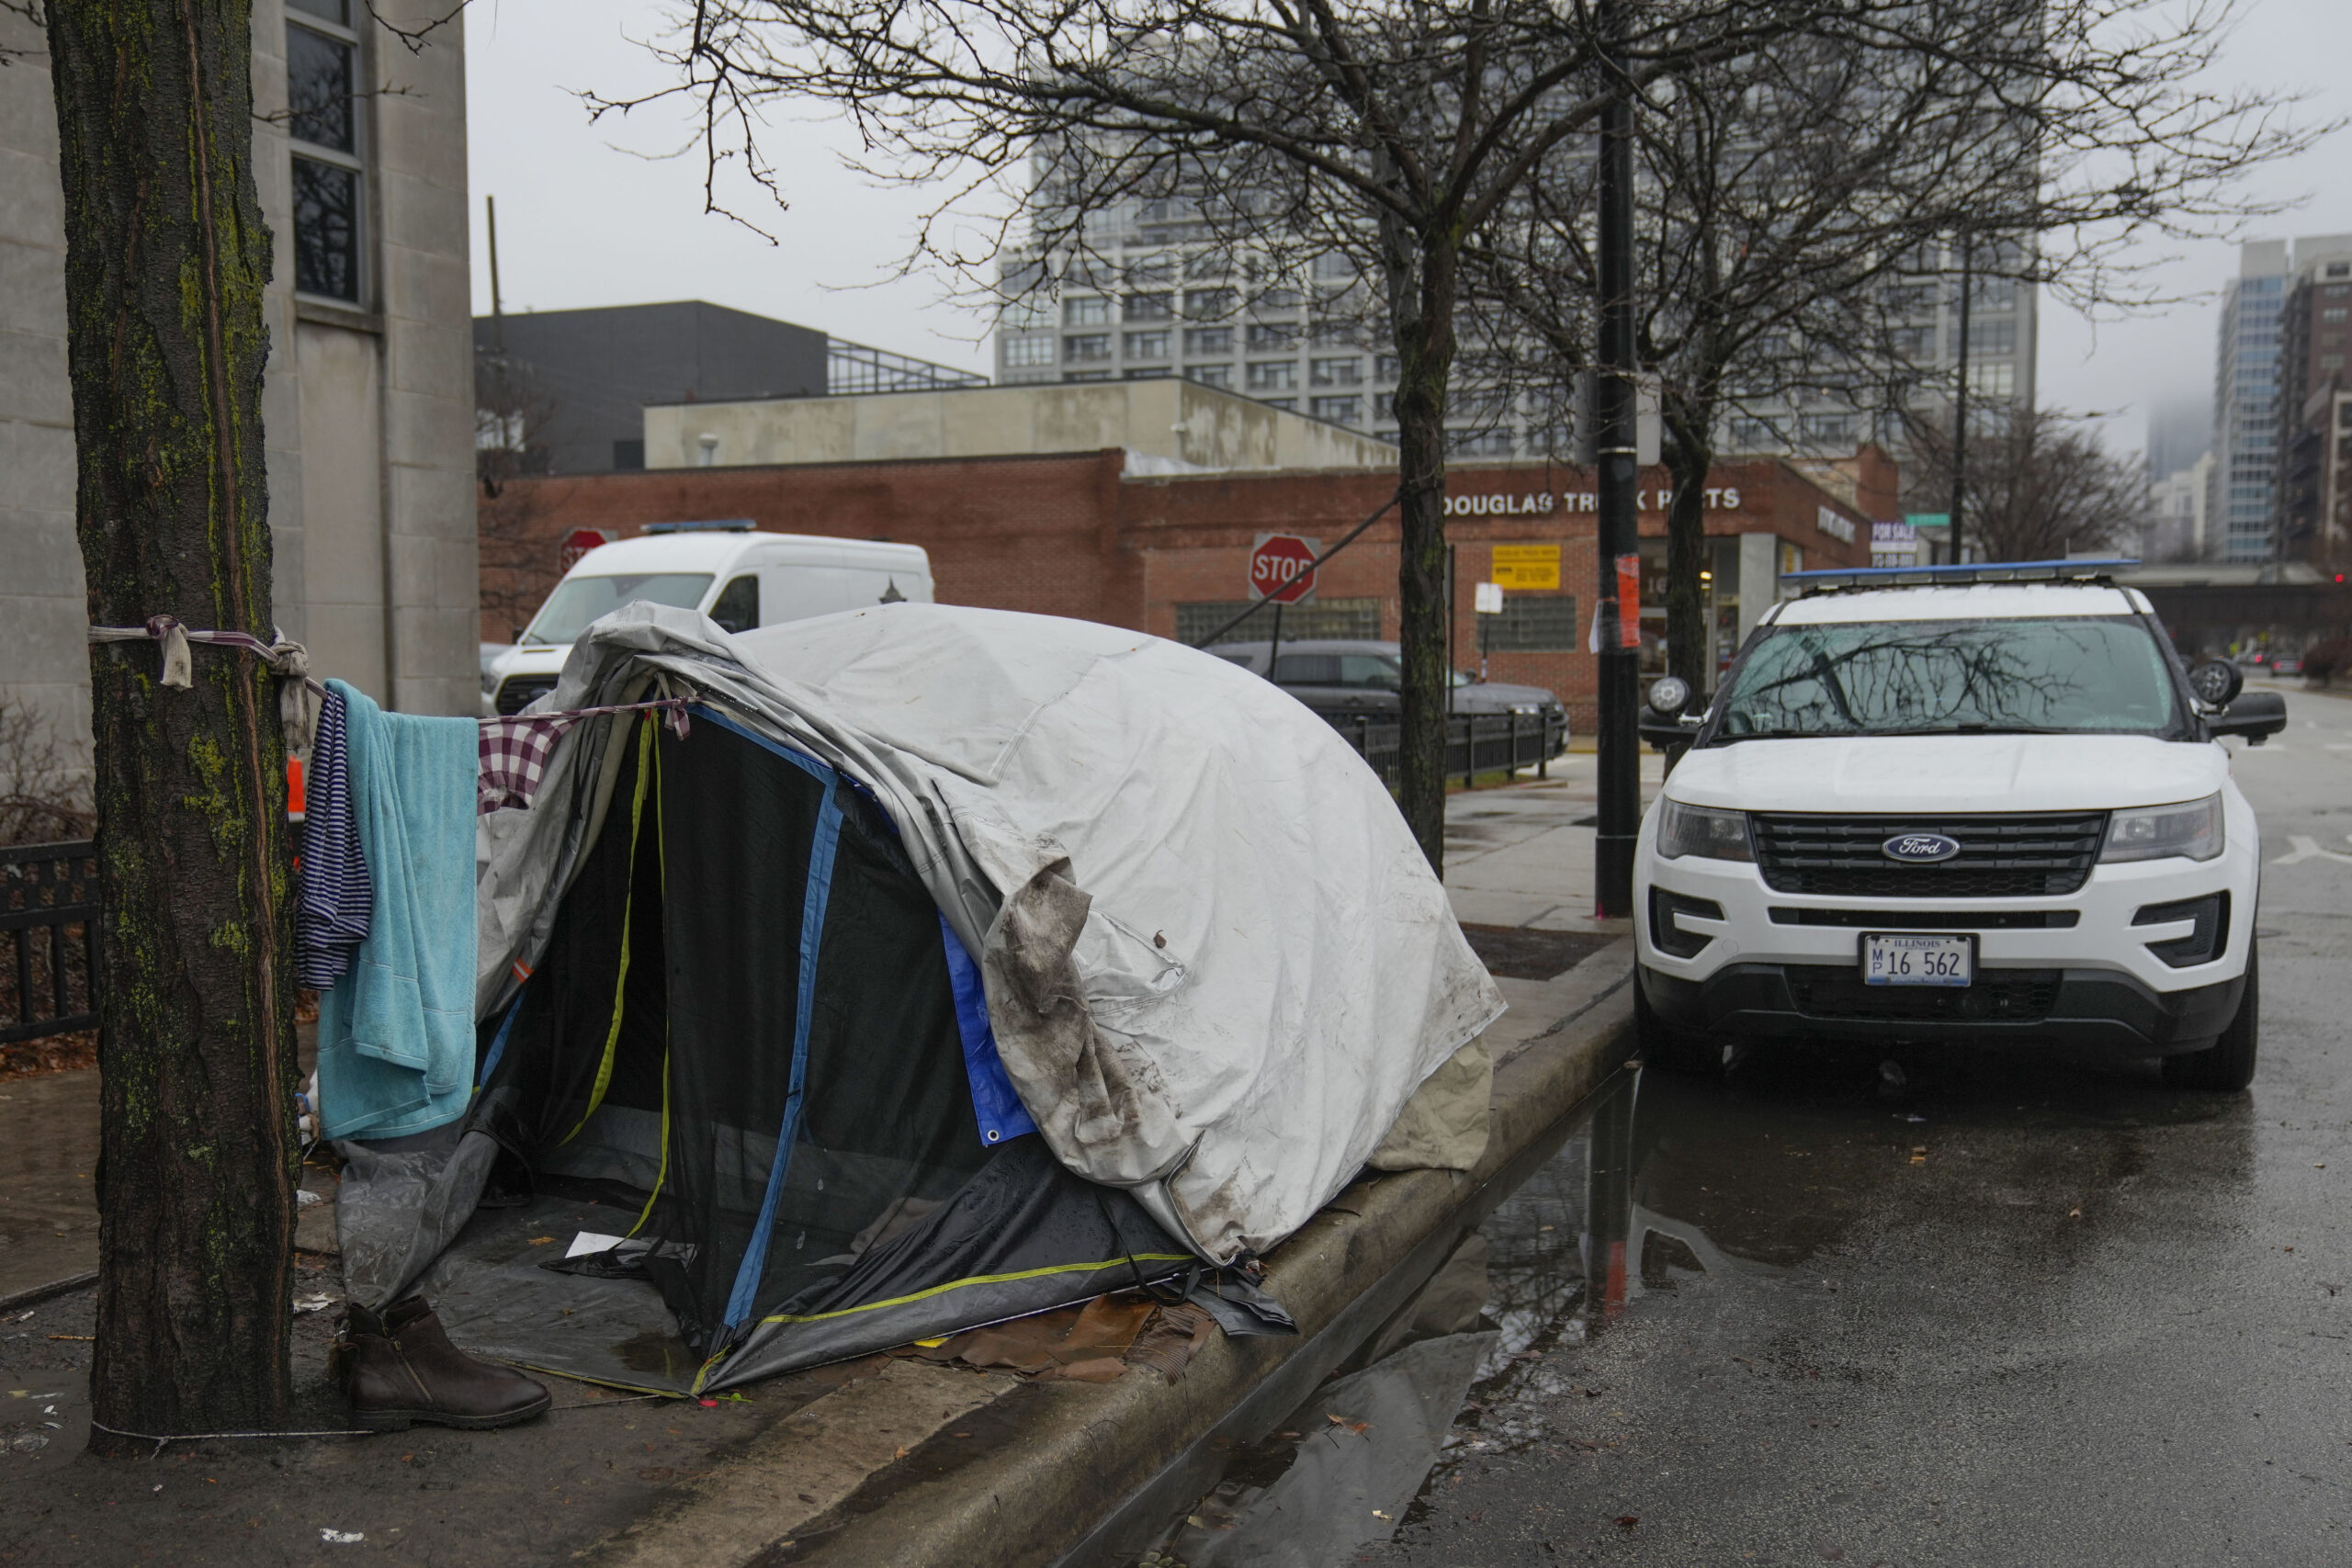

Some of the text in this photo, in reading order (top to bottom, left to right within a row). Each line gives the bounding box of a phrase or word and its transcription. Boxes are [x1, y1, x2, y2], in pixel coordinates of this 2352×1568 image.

[1443, 487, 1741, 515] DOUGLAS TRK PTS
[1872, 523, 1891, 540] FOR
[1893, 523, 1917, 540] SALE
[1254, 554, 1312, 583] STOP
[1898, 837, 1941, 854] Ford
[1894, 940, 1940, 948] ILLINOIS
[1887, 951, 1960, 976] 16 562
